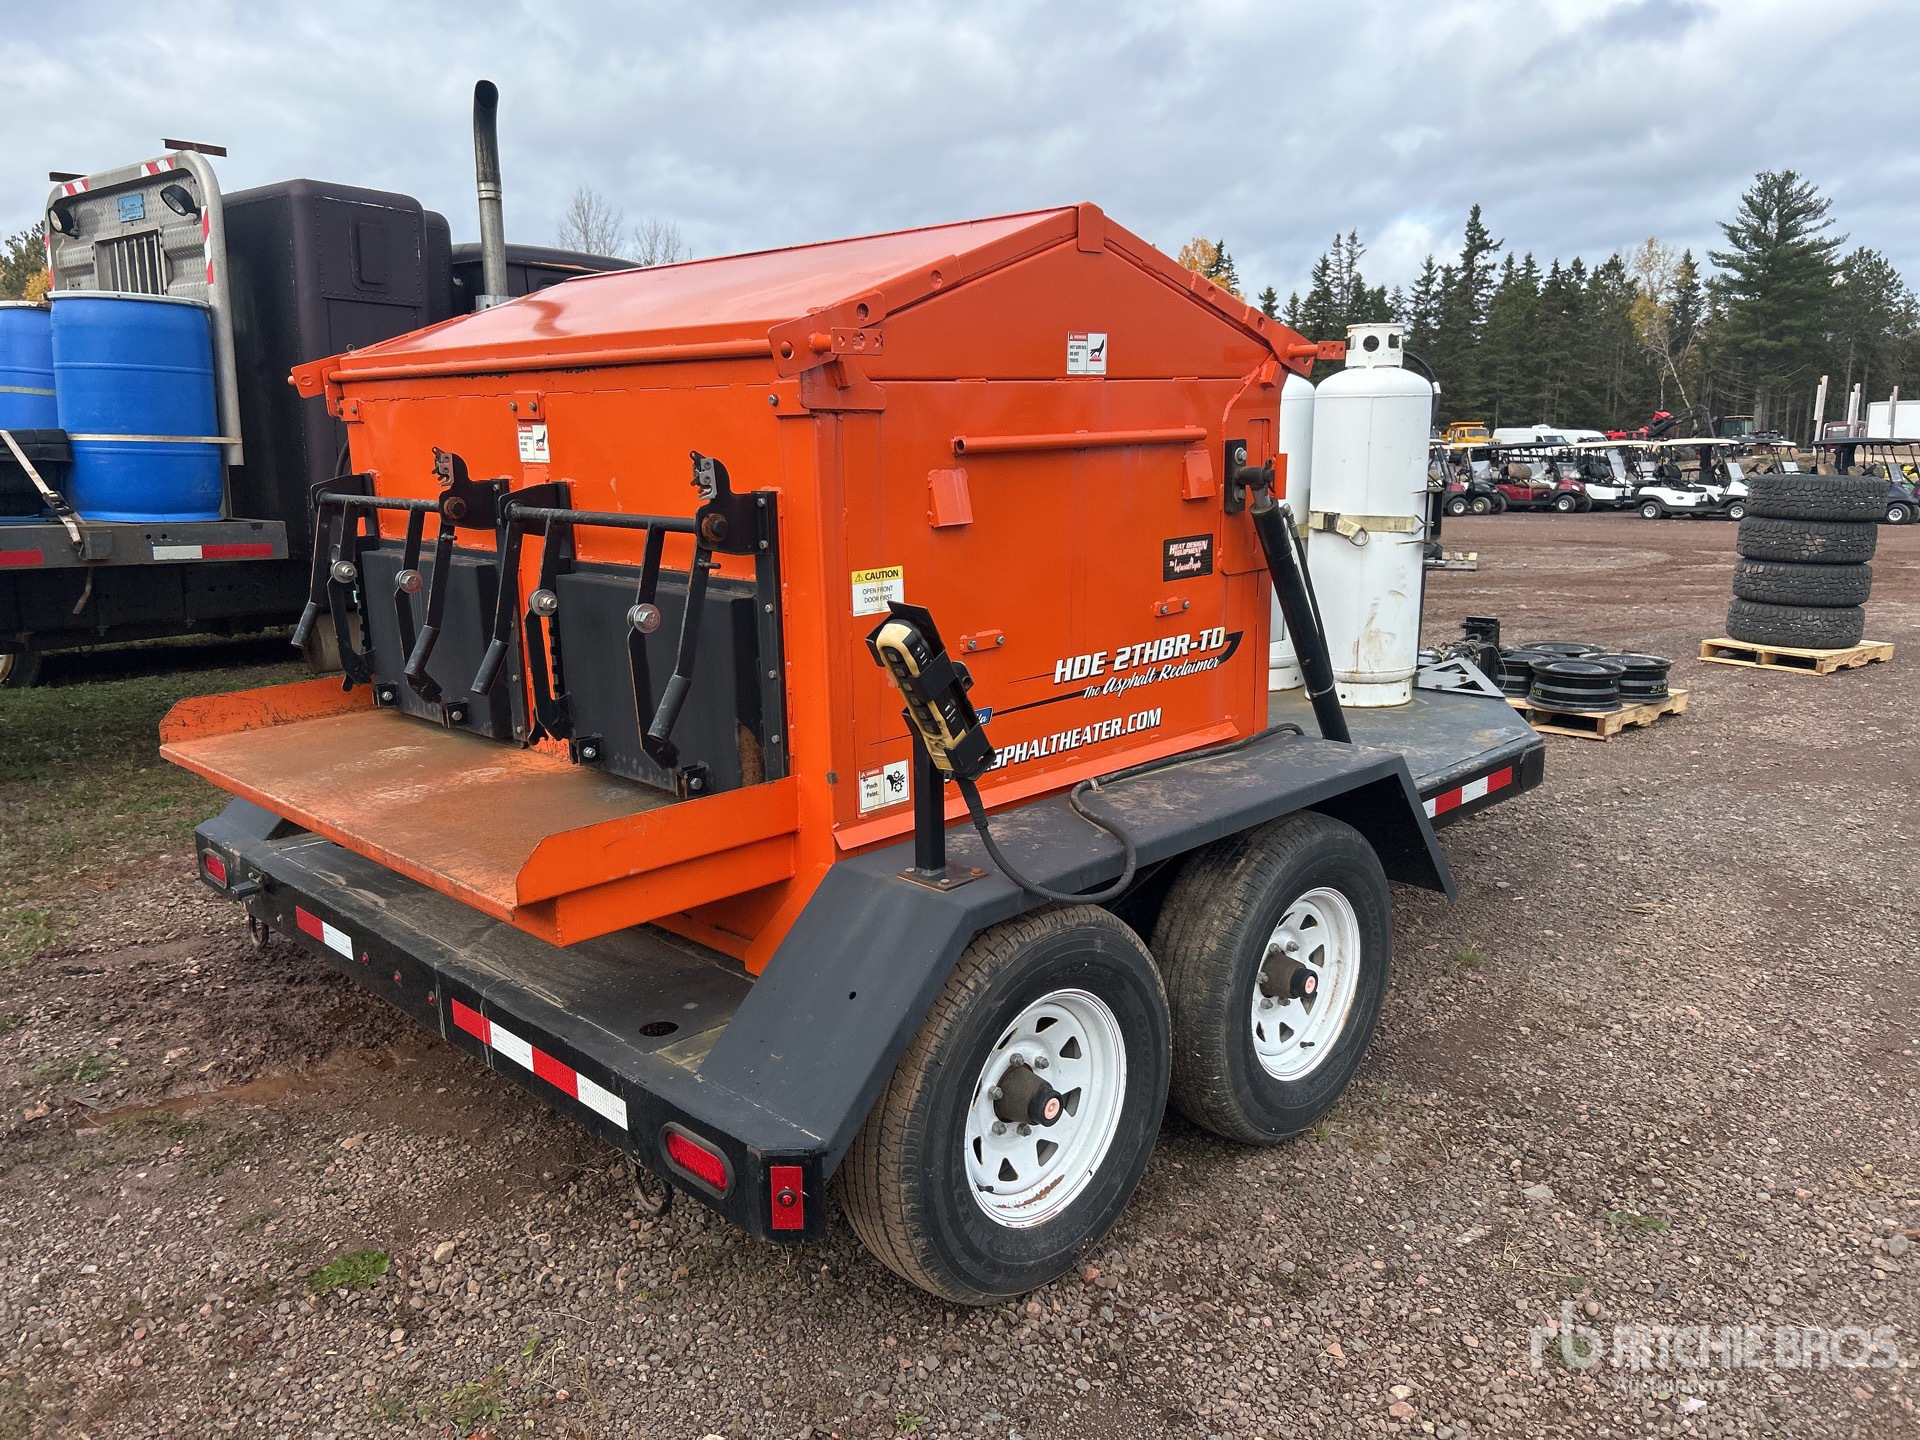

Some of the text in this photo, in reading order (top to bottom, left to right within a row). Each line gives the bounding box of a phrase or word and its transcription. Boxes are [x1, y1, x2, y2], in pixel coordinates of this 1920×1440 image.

[865, 569, 899, 580] CAUTION
[877, 585, 893, 593] FRONT
[1053, 626, 1226, 684] HDE 2THBR-TD
[1083, 656, 1220, 699] The Asphalt Reclaimer
